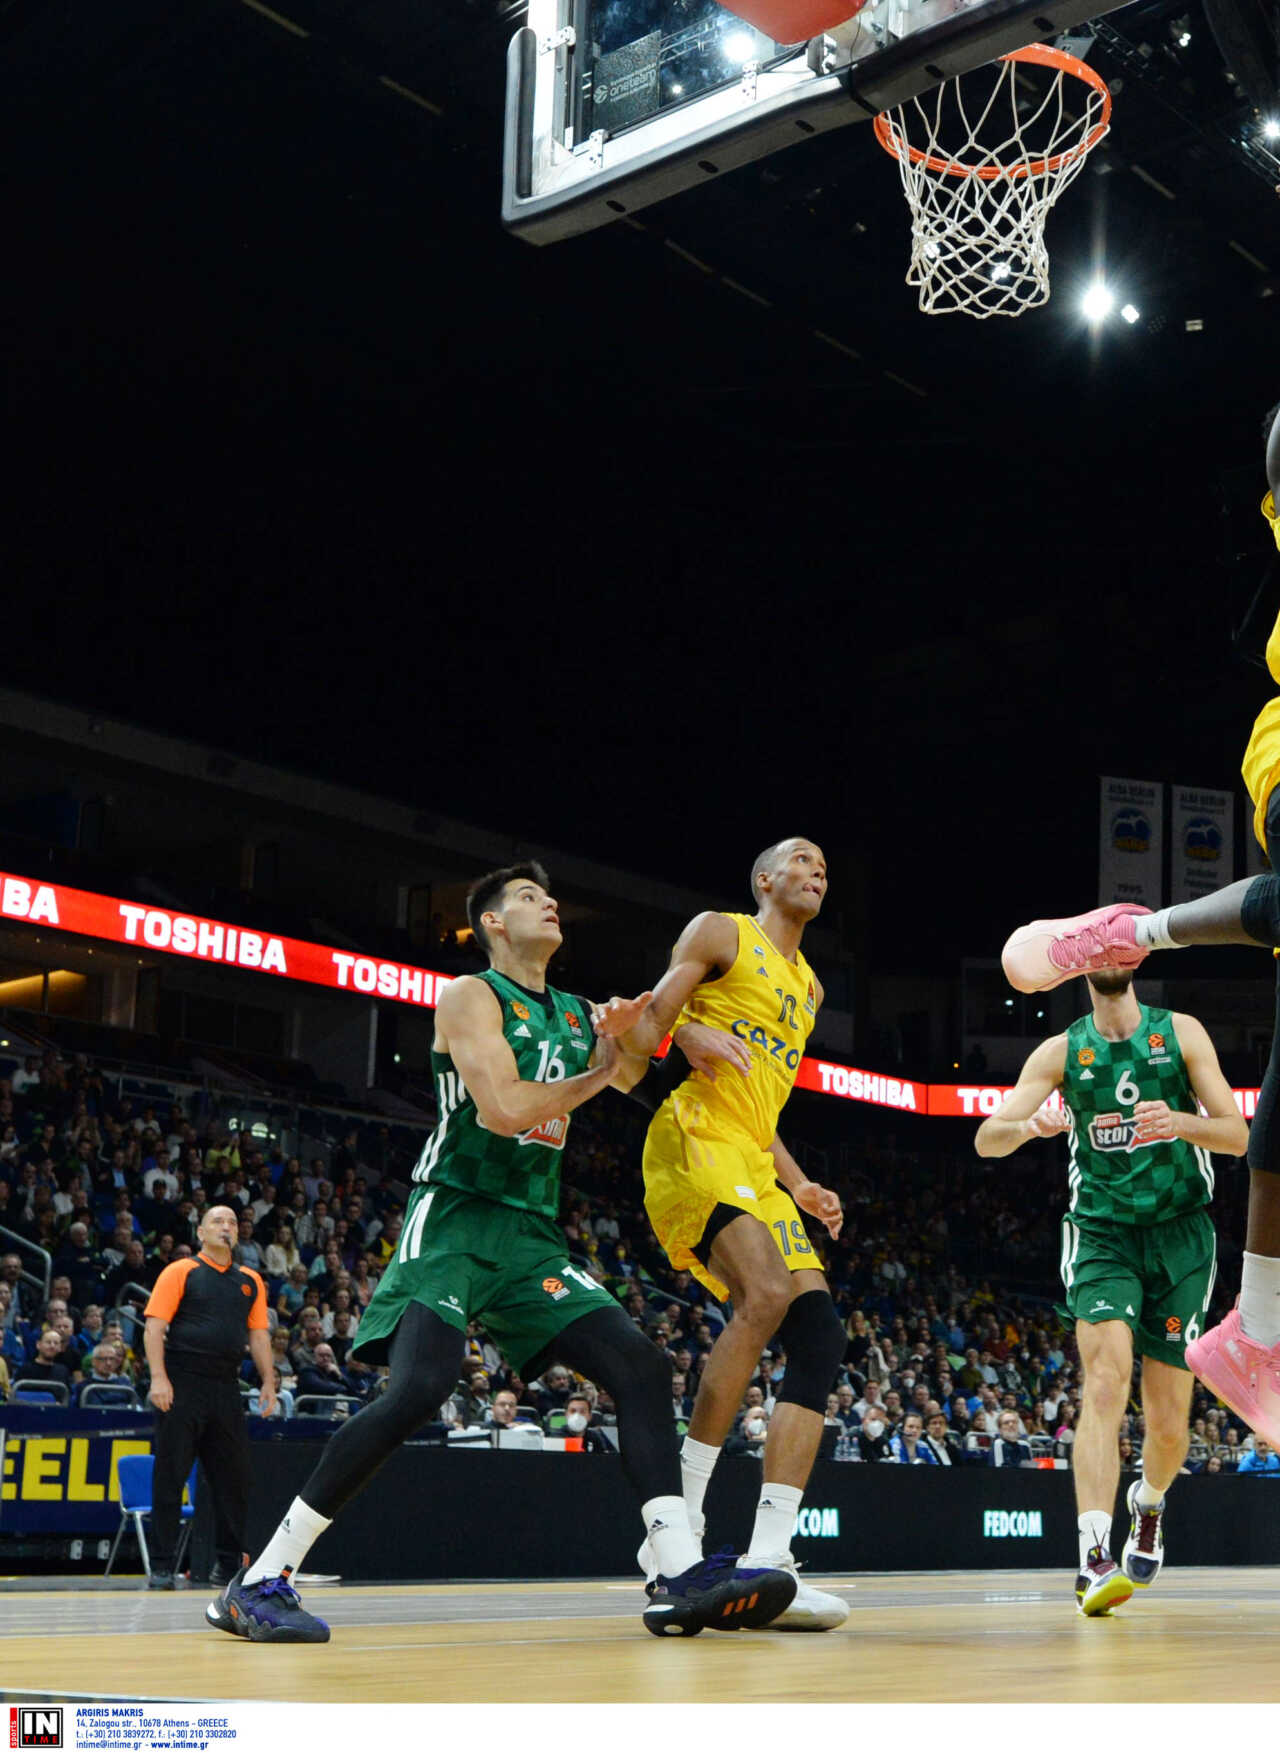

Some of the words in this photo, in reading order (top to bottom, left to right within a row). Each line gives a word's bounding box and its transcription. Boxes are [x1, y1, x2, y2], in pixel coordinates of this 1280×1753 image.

[0, 877, 60, 924] BA
[119, 904, 287, 973] TOSHIBA
[534, 1040, 566, 1083] 16
[818, 1063, 916, 1110] TOSHIBA
[1115, 1070, 1140, 1106] 6
[773, 1220, 811, 1256] 19
[983, 1510, 1042, 1537] FEDCOM
